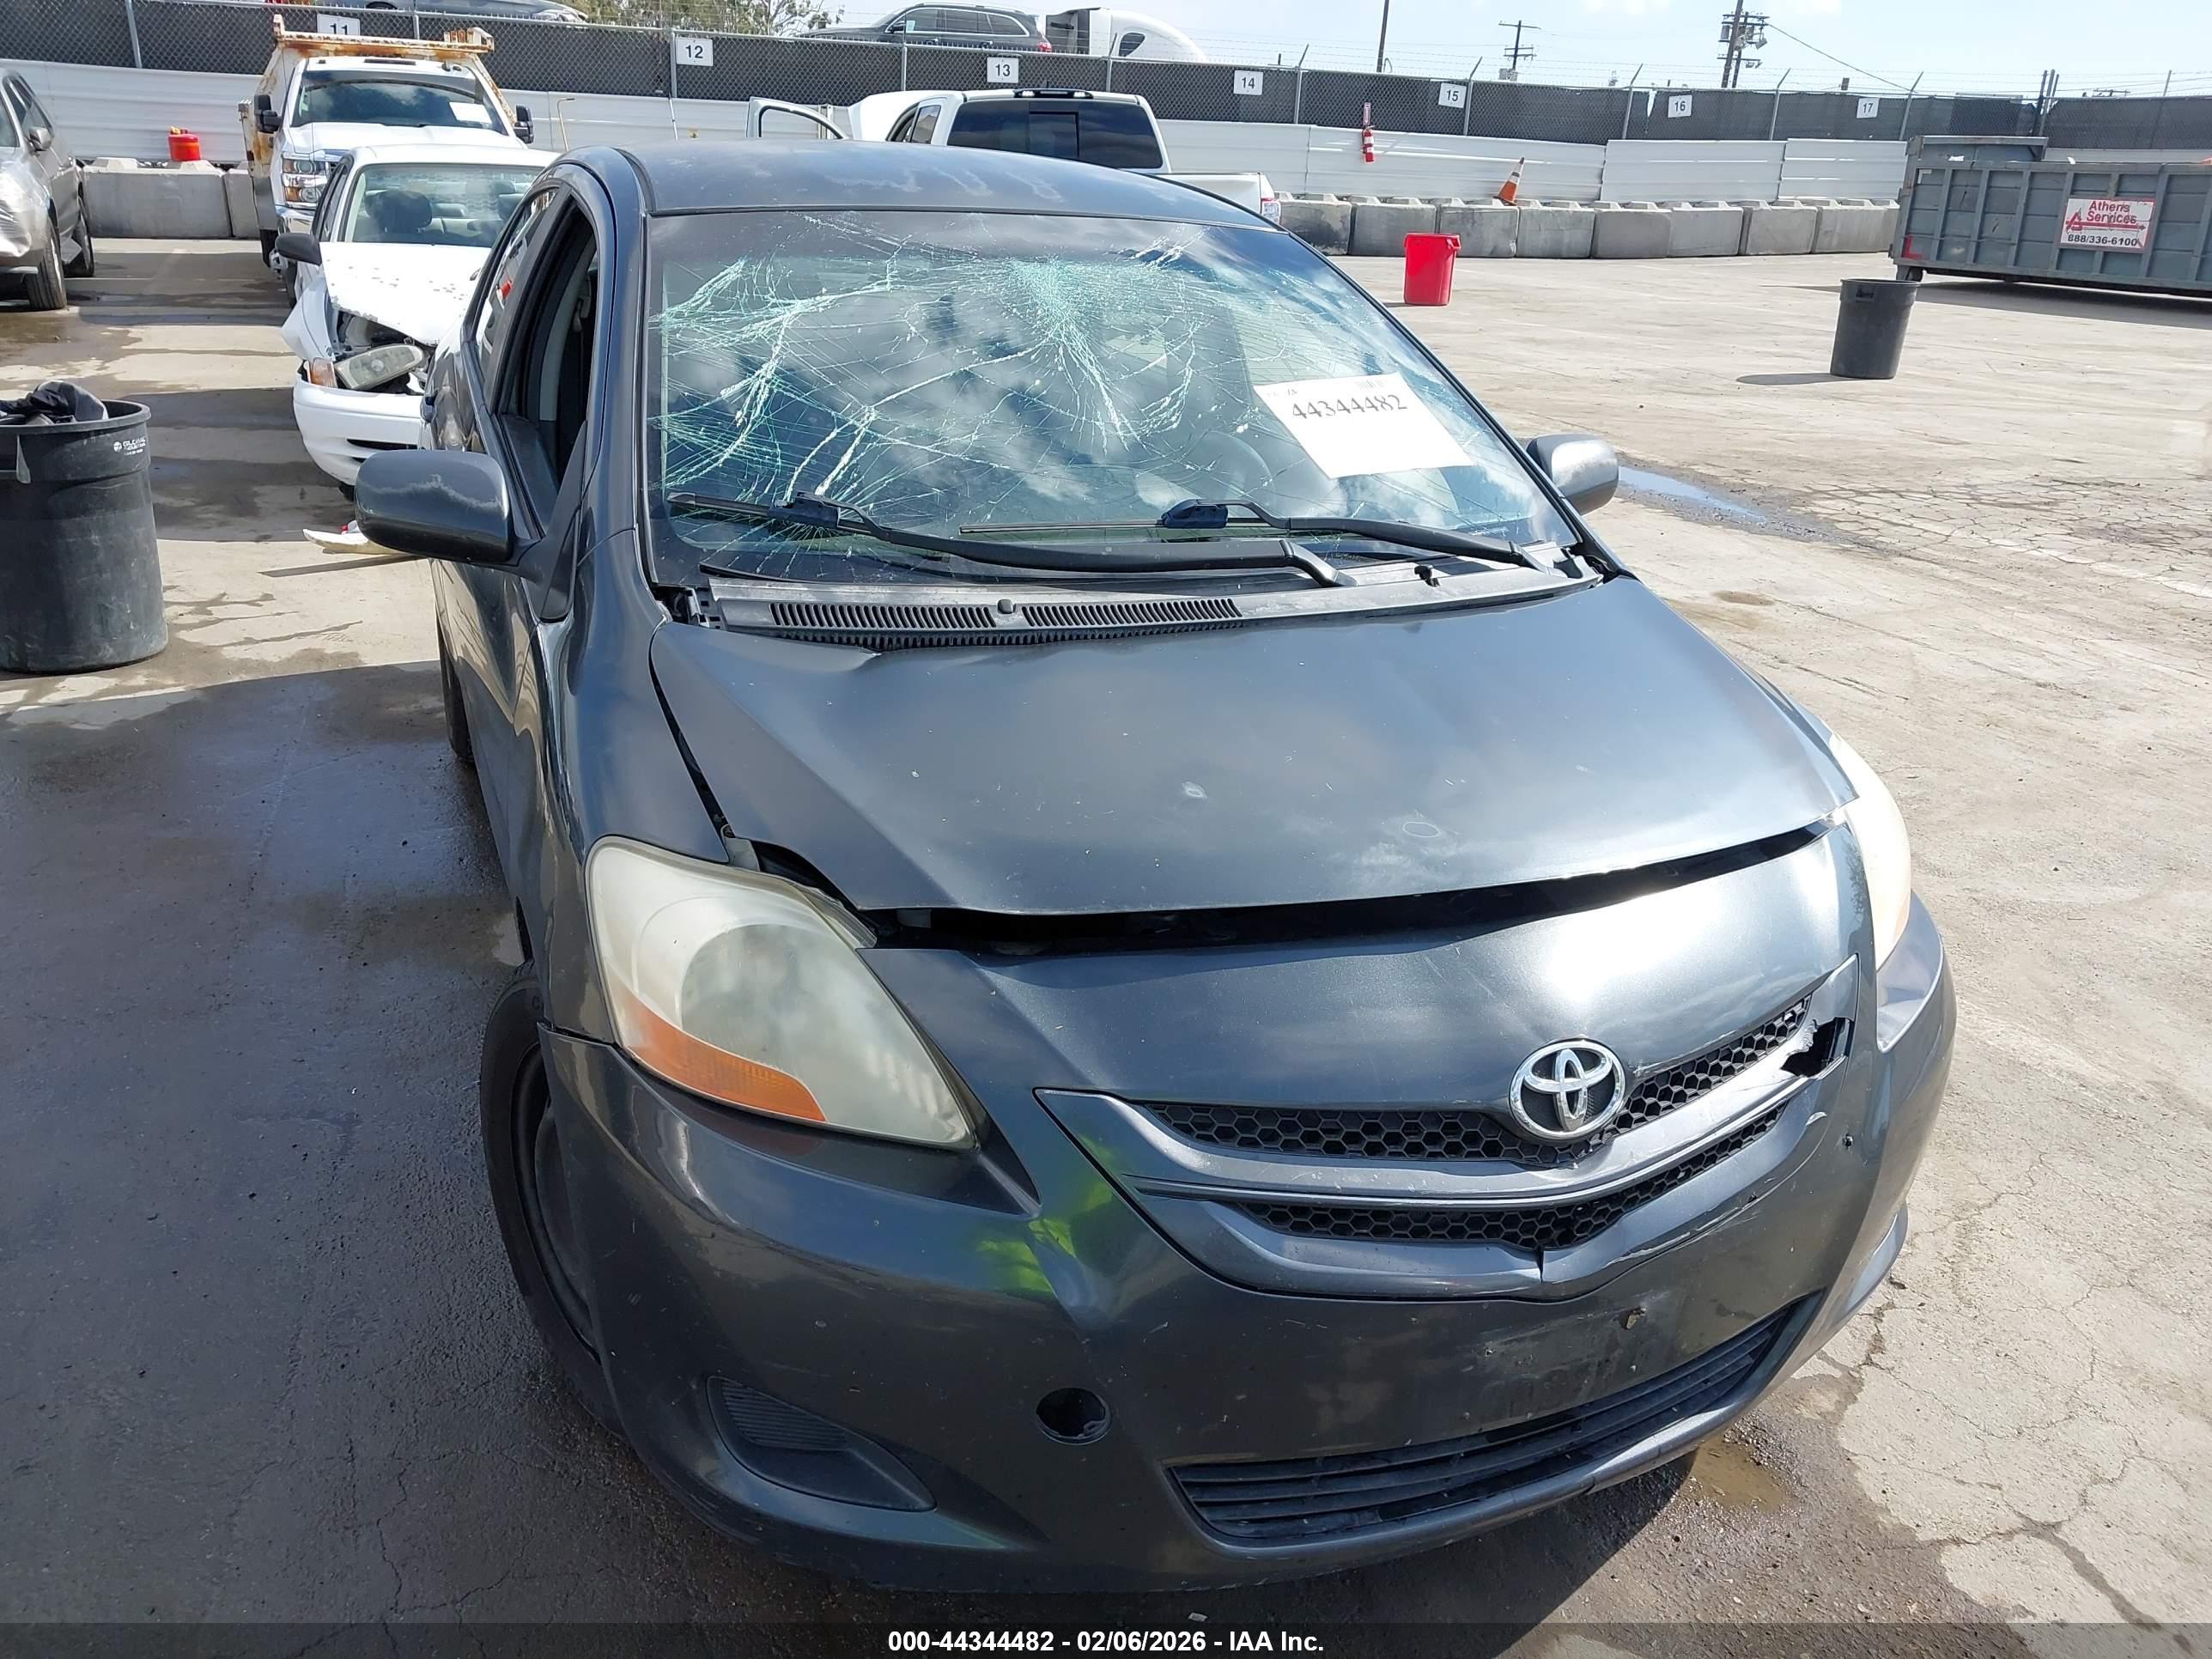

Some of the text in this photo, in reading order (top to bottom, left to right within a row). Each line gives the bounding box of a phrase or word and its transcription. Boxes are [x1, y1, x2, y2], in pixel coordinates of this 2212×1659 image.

[330, 23, 348, 35] 11
[685, 45, 703, 58] 12
[995, 64, 1011, 76] 13
[1242, 76, 1255, 88] 14
[1447, 89, 1459, 101] 15
[1674, 100, 1686, 112] 16
[1863, 102, 1874, 113] 17
[2088, 201, 2130, 213] Athens
[2087, 210, 2137, 224] Services
[2068, 234, 2137, 246] 888/336-6100
[1292, 394, 1407, 419] 44344482
